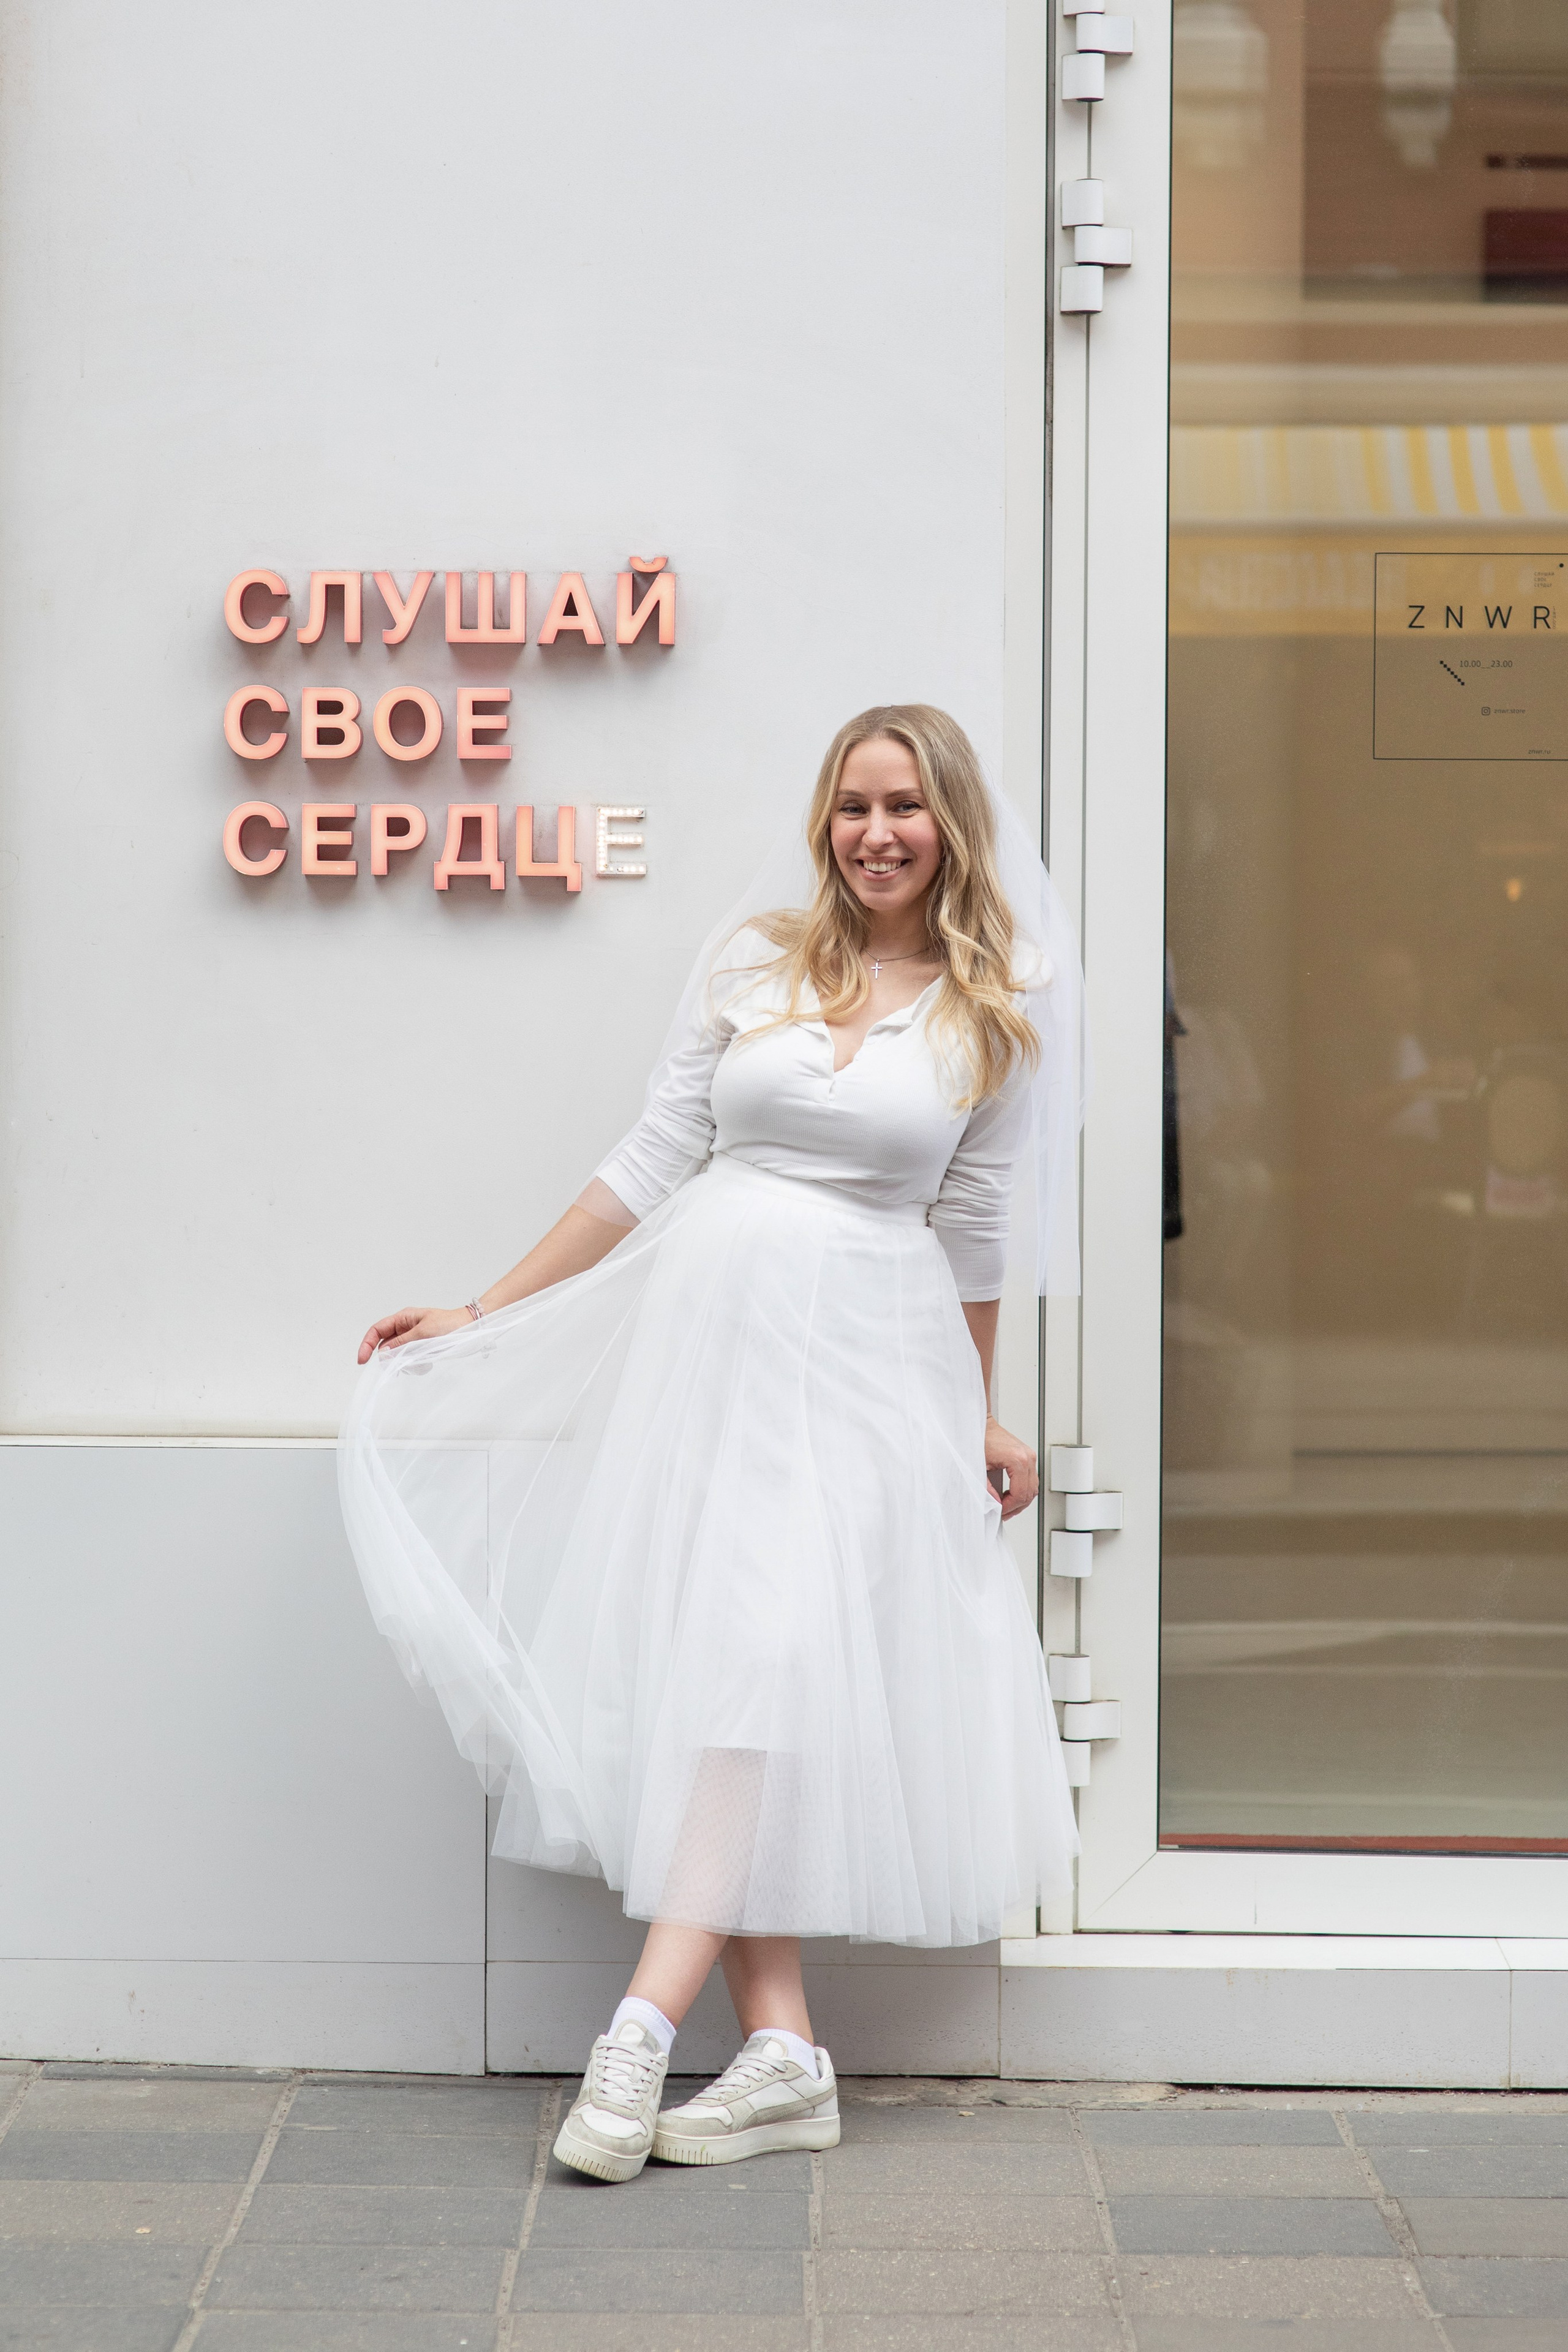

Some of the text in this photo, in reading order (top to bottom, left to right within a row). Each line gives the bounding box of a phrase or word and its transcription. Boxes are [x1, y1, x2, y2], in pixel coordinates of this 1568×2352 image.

[224, 556, 676, 645] СЛУШАЙ
[1408, 605, 1551, 629] ZNWR
[224, 685, 512, 761] СВОЕ
[223, 801, 647, 892] СЕРДЦЕ
